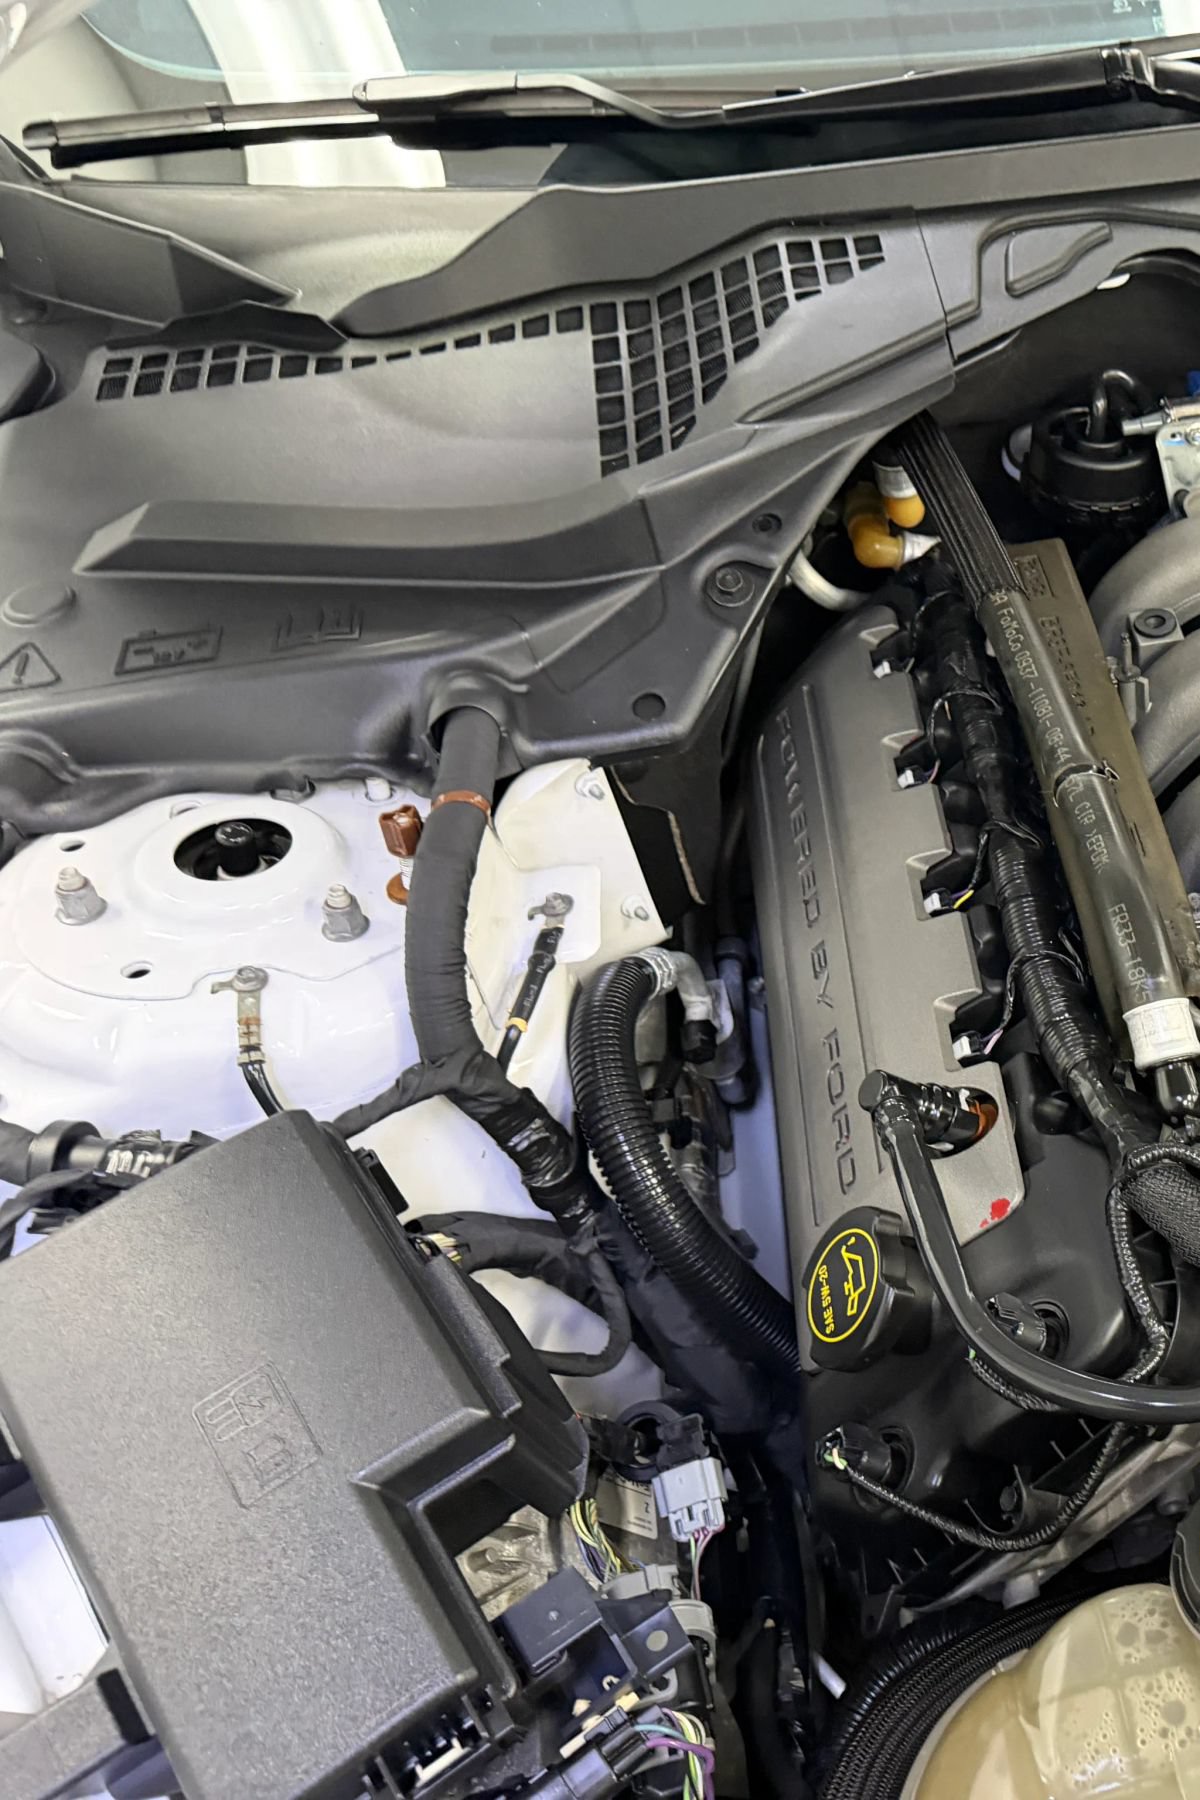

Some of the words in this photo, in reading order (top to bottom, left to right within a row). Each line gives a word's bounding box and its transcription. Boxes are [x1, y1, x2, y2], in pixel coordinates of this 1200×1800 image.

[997, 607, 1025, 652] FoMoCo
[776, 707, 821, 928] POWERED
[810, 940, 834, 1009] BY
[822, 1028, 857, 1195] FORD
[819, 1264, 832, 1308] 5W-20
[823, 1306, 835, 1335] SAE
